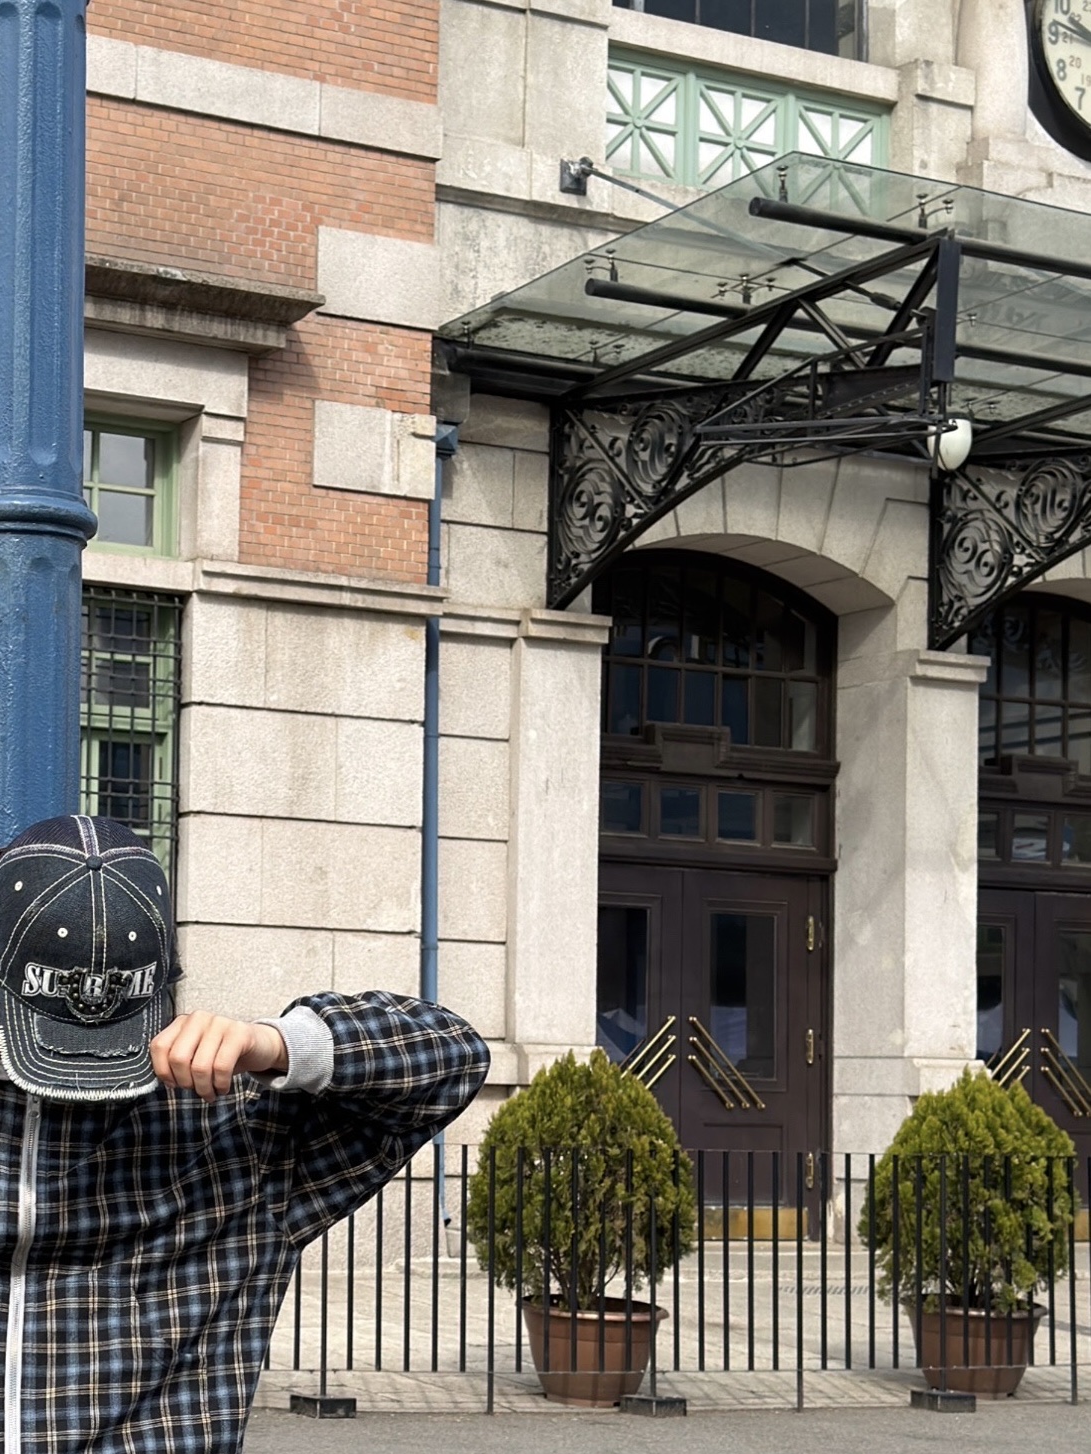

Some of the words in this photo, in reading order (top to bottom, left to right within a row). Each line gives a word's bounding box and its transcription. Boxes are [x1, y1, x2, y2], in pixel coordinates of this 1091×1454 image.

[1048, 20, 1059, 45] 9
[1056, 58, 1067, 82] 8
[1069, 55, 1082, 69] 20
[1074, 86, 1086, 111] 7
